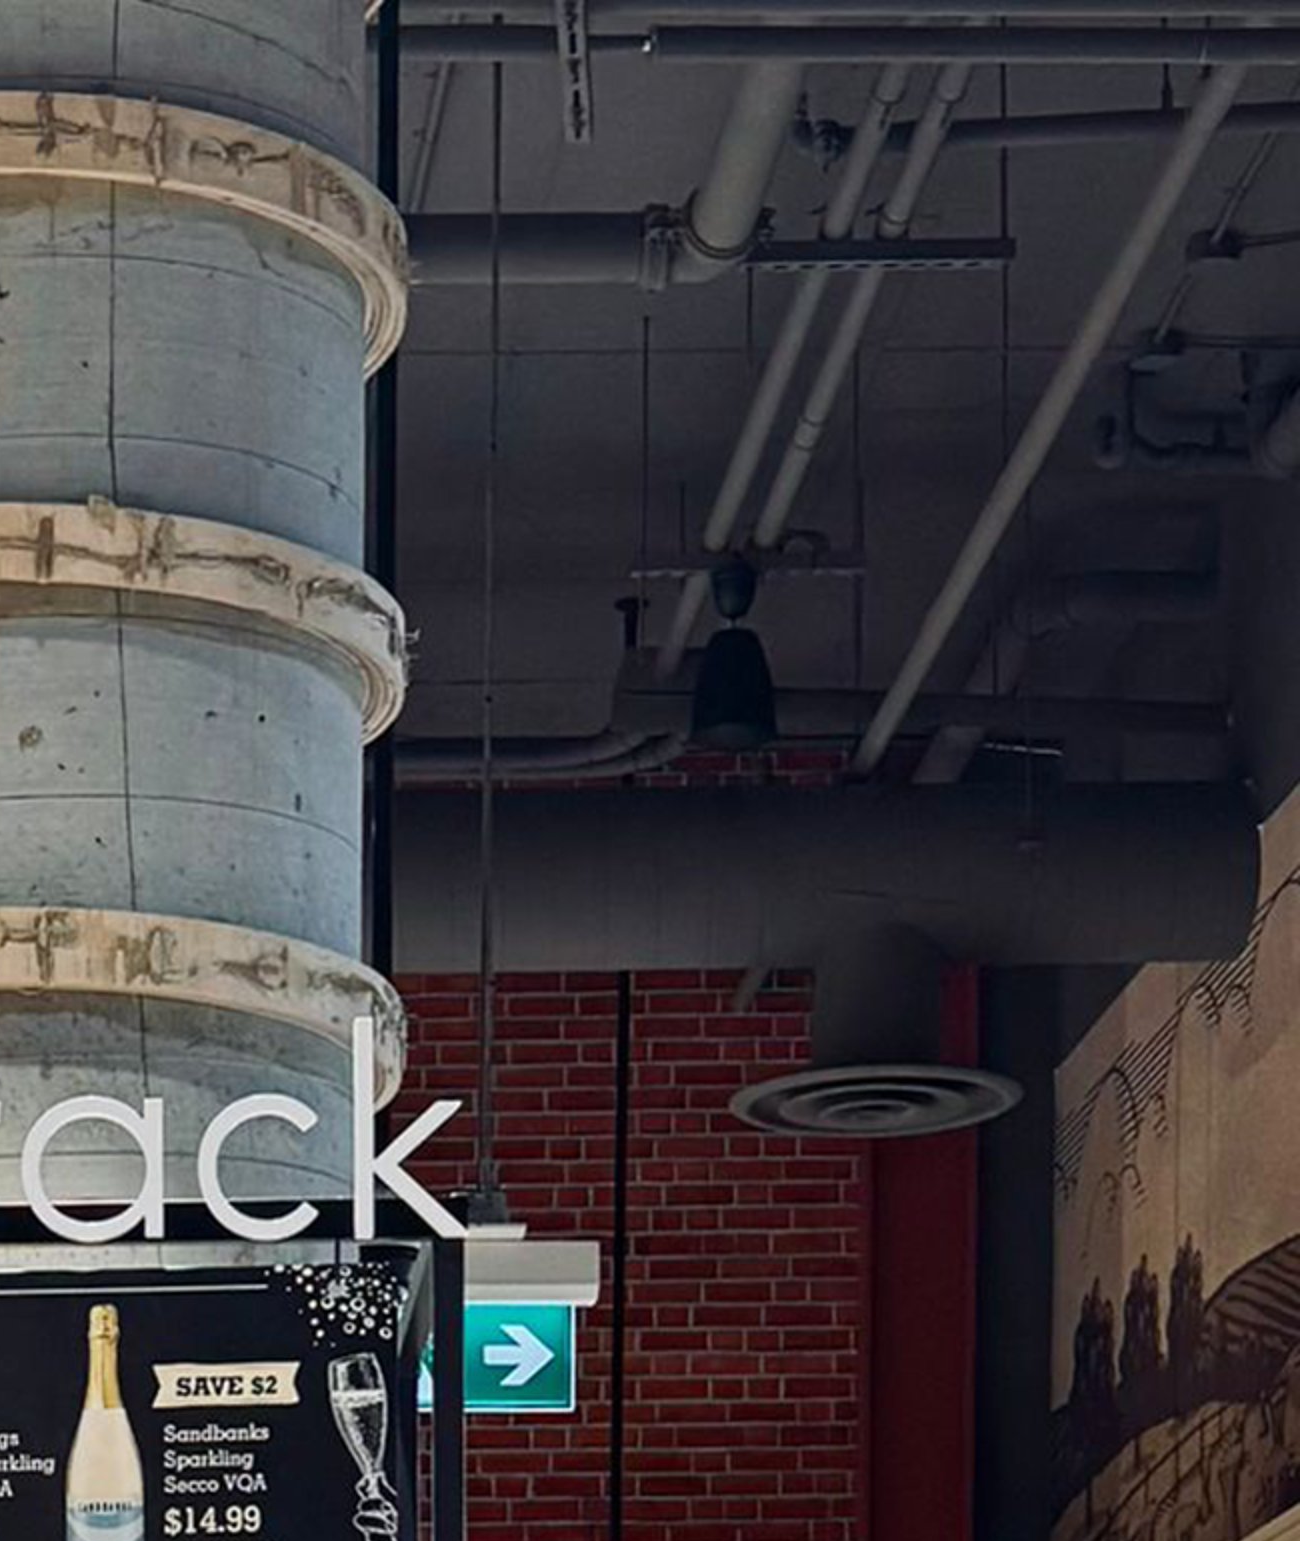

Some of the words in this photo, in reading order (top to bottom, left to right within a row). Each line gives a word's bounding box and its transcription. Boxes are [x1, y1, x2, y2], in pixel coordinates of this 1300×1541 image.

[175, 1375, 244, 1398] SAVE
[250, 1375, 278, 1396] $2
[162, 1423, 270, 1444] Sandbanks
[162, 1450, 255, 1472] Sparkling
[162, 1476, 220, 1494] Secco
[222, 1473, 268, 1494] VQA
[163, 1505, 262, 1536] $14.99
